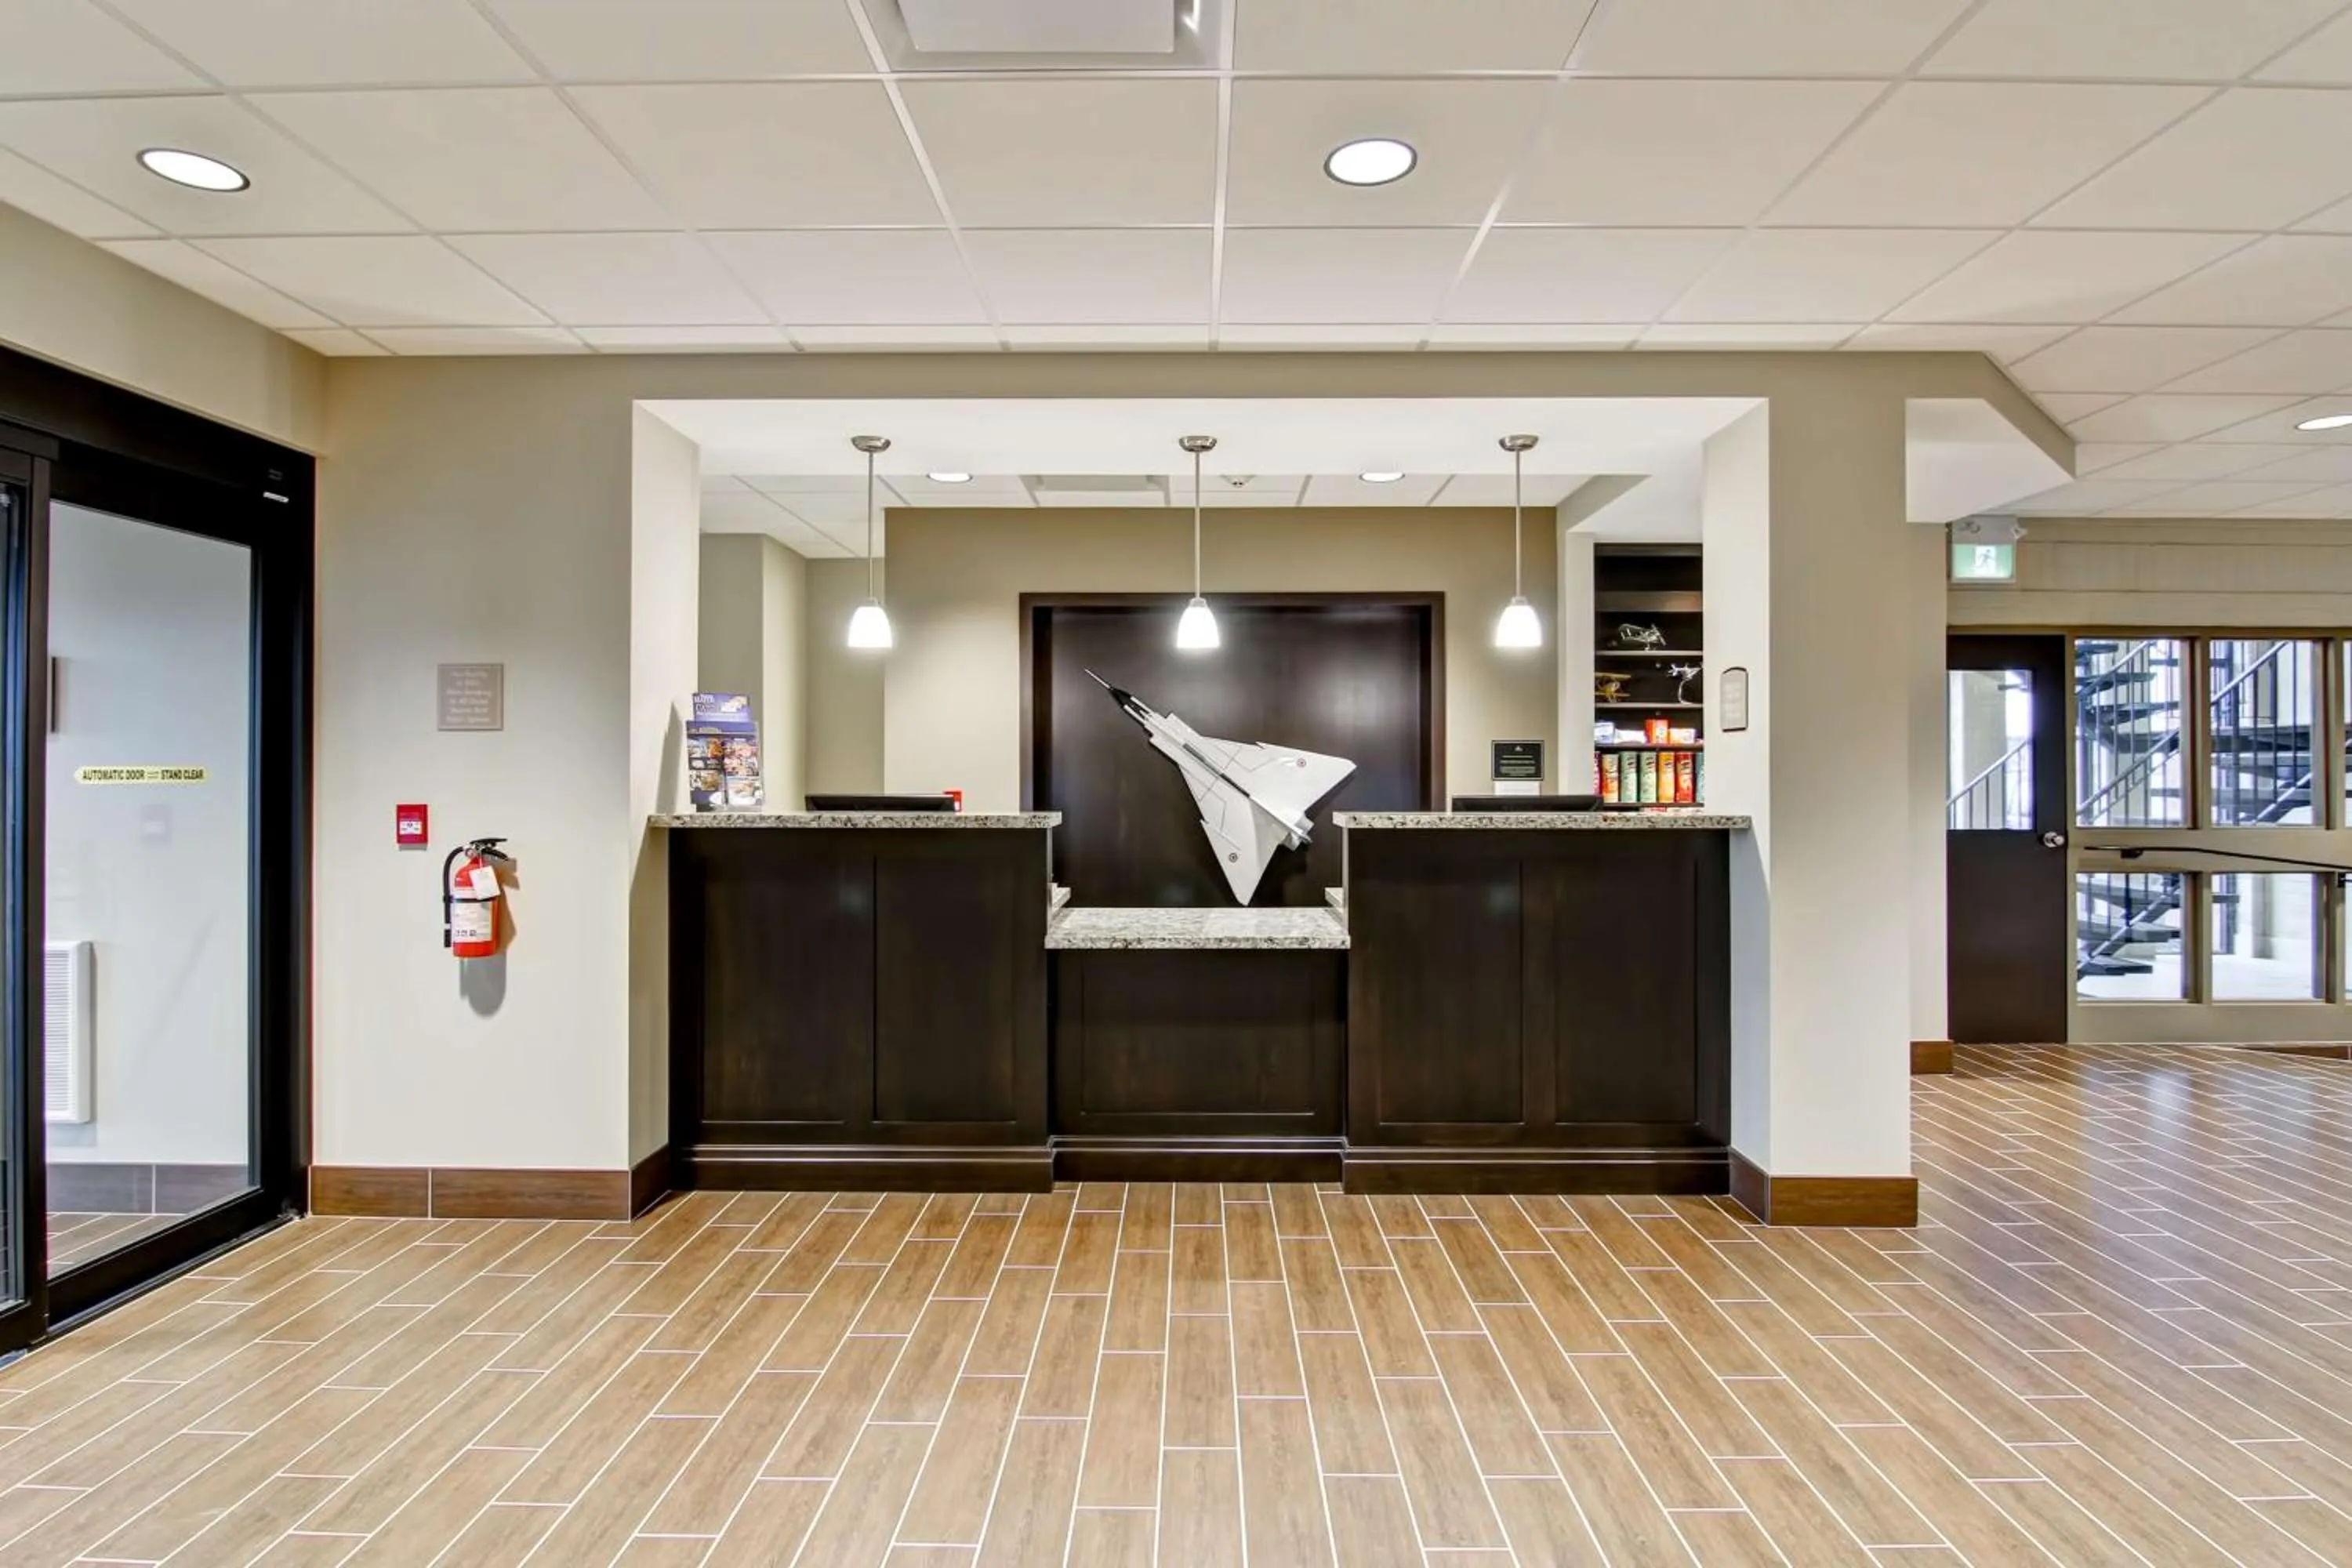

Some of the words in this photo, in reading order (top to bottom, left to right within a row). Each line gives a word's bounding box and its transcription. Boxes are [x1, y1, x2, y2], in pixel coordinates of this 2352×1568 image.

[82, 769, 124, 780] AUTOMATIC
[125, 769, 145, 780] DOOR
[161, 769, 182, 780] STAND
[183, 769, 203, 780] CLEAR
